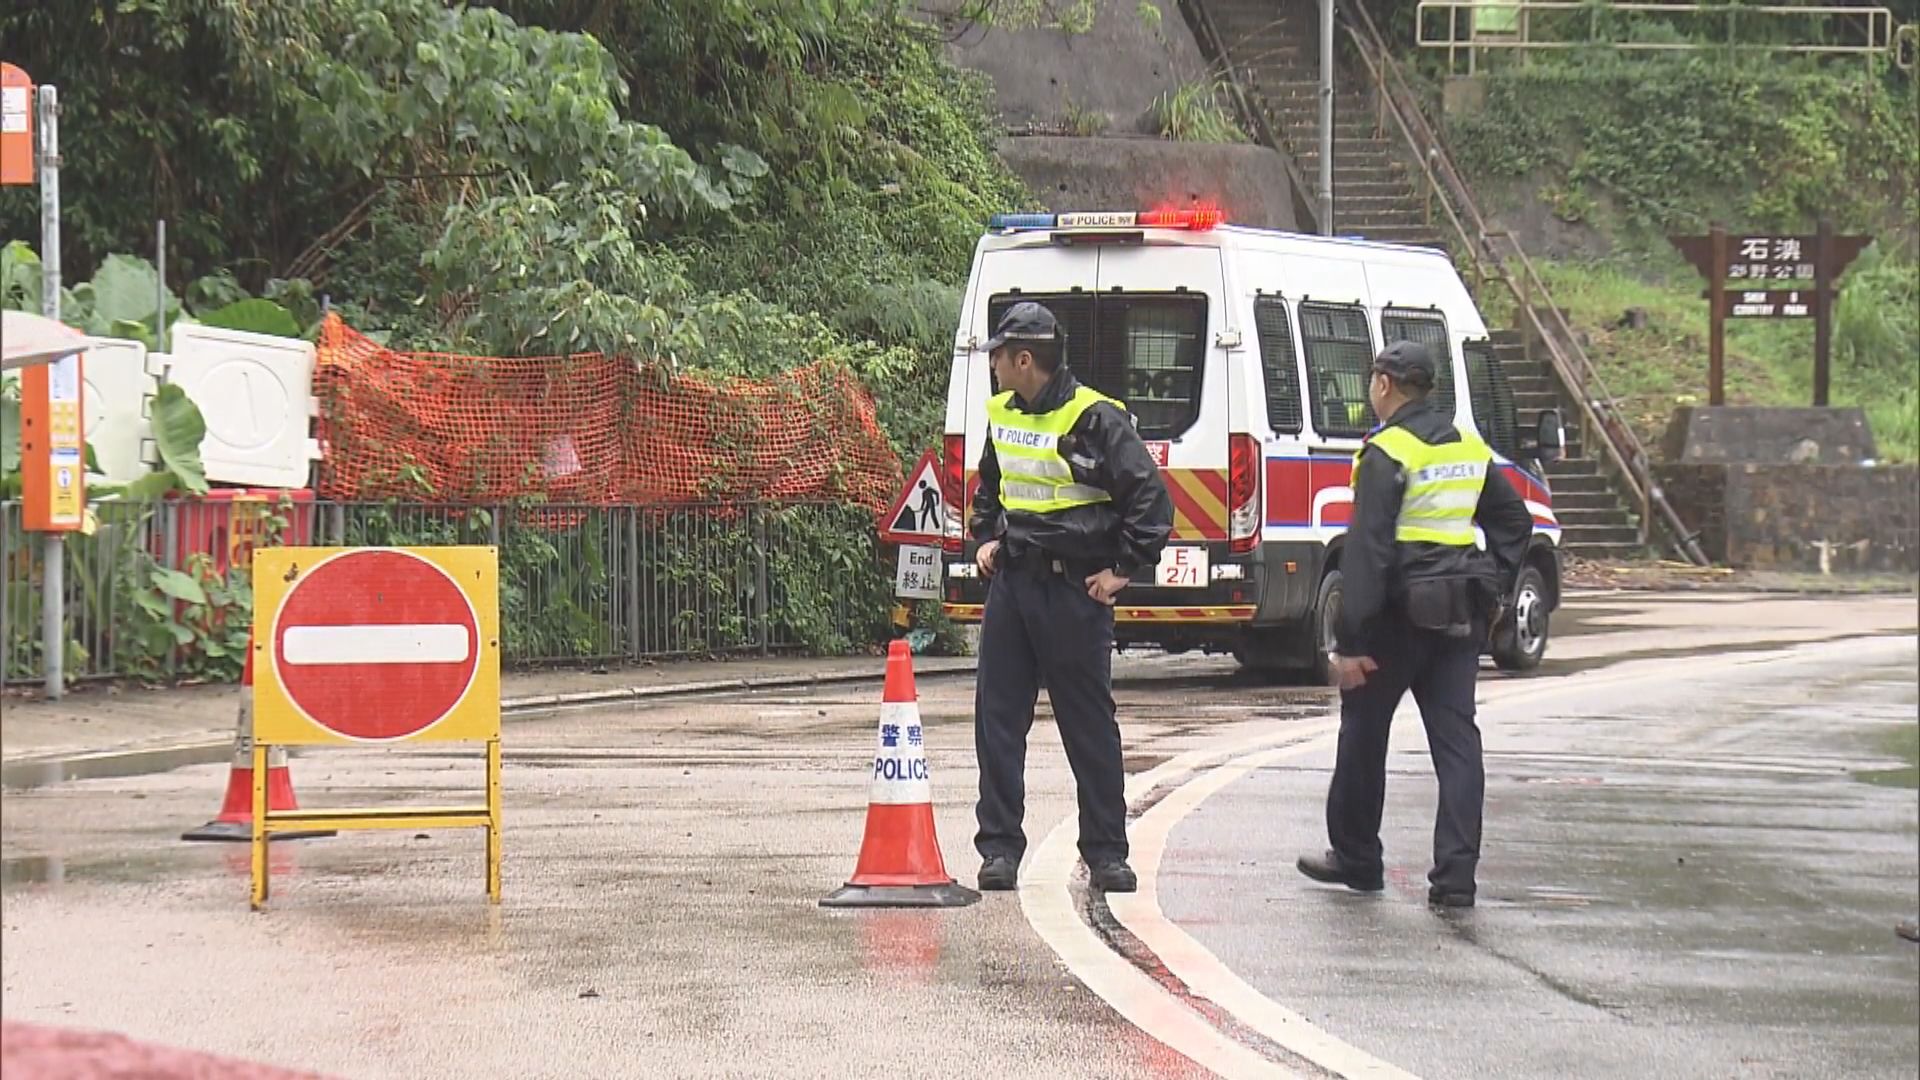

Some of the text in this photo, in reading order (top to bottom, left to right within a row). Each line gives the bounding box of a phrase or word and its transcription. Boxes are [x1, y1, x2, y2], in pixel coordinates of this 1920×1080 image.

[1077, 215, 1116, 226] POLICE
[1006, 430, 1041, 447] POLICE
[909, 552, 934, 566] End
[1175, 549, 1189, 565] E
[901, 570, 939, 591] 終止
[1166, 568, 1198, 584] 2/1
[881, 724, 923, 747] 警察
[874, 757, 929, 781] POLICE
